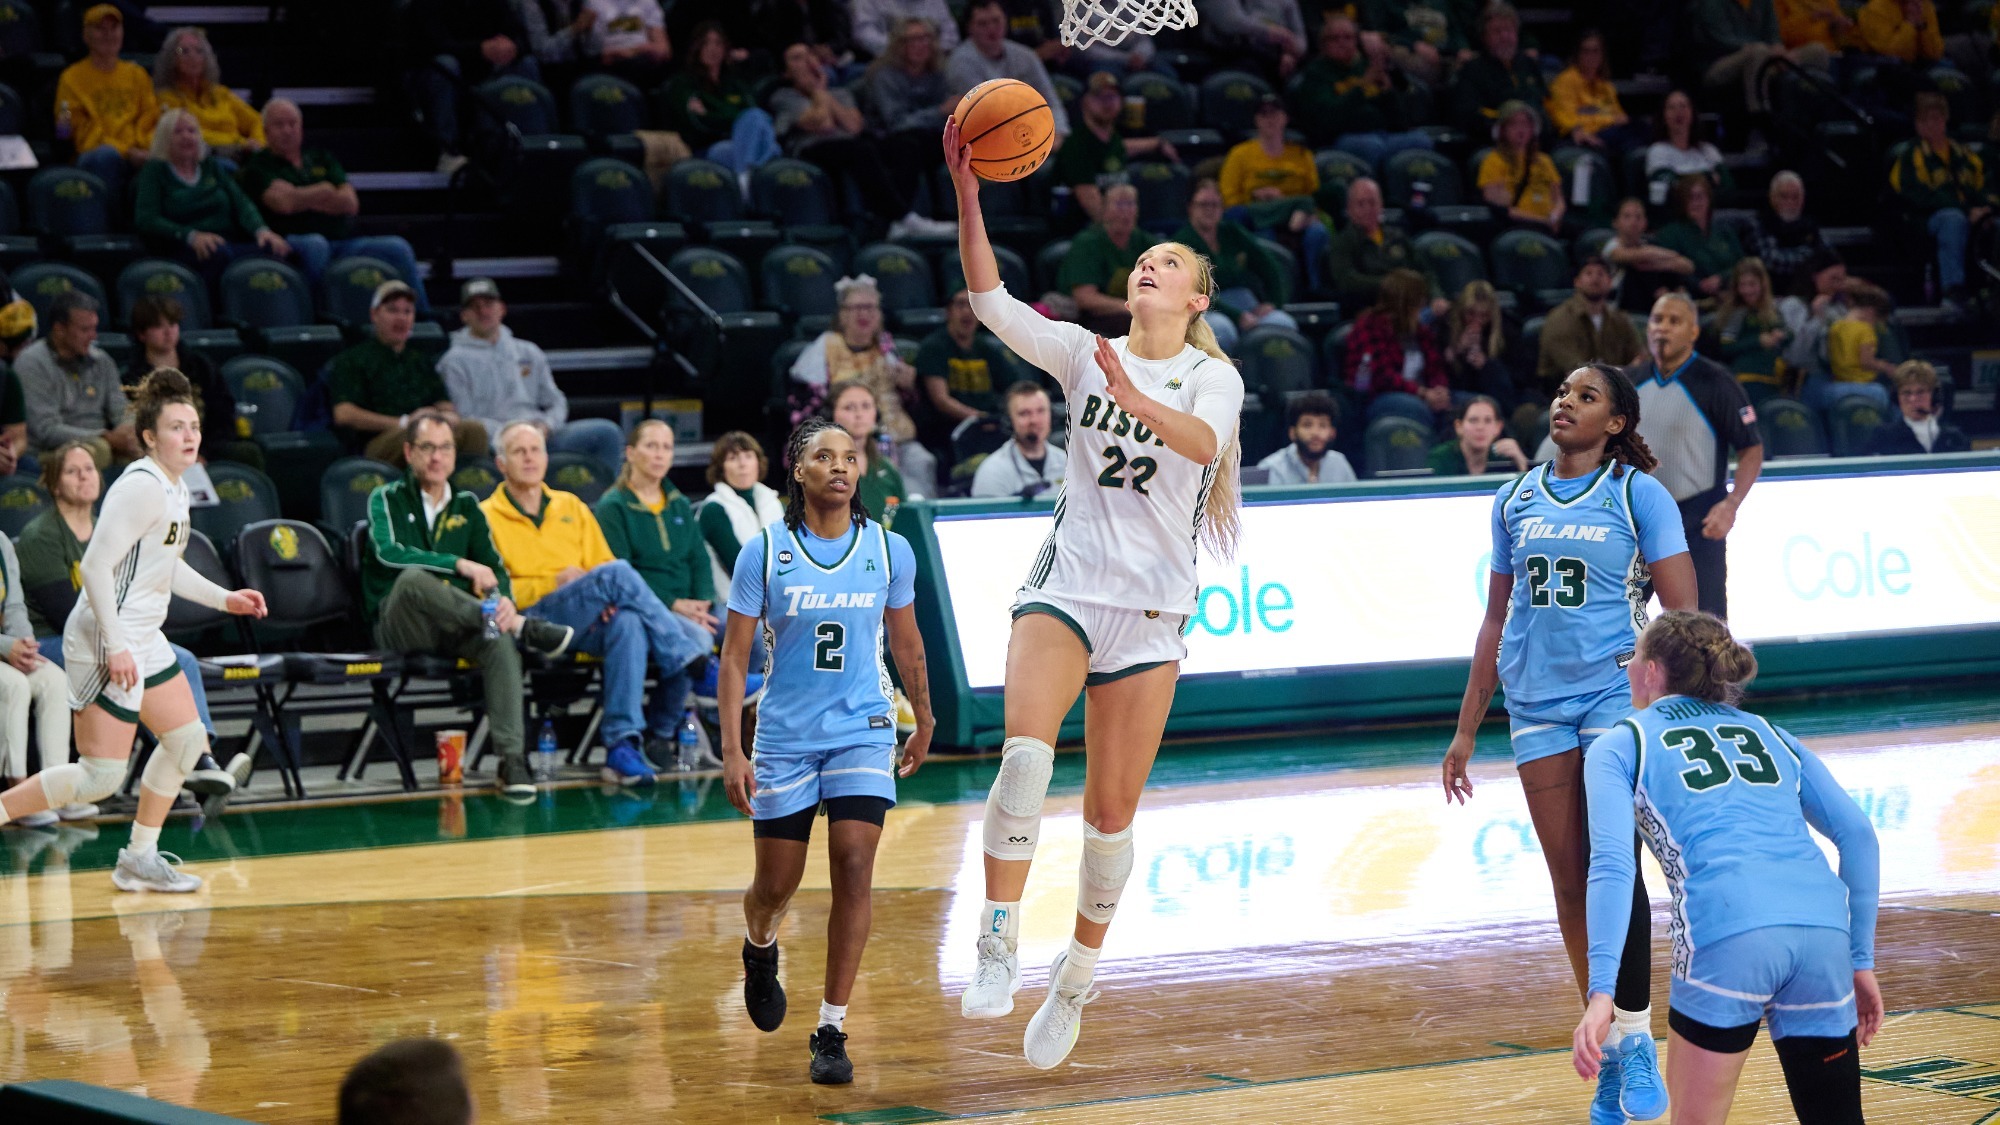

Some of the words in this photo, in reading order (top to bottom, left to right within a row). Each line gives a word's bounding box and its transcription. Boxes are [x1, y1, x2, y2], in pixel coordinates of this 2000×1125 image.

[1010, 150, 1047, 176] EVO
[1080, 393, 1165, 447] BISO
[1097, 445, 1158, 496] 22
[1526, 554, 1587, 608] 23
[1783, 531, 1912, 600] Cole
[1183, 565, 1294, 637] ole
[814, 621, 845, 672] 2
[1660, 724, 1782, 793] 33
